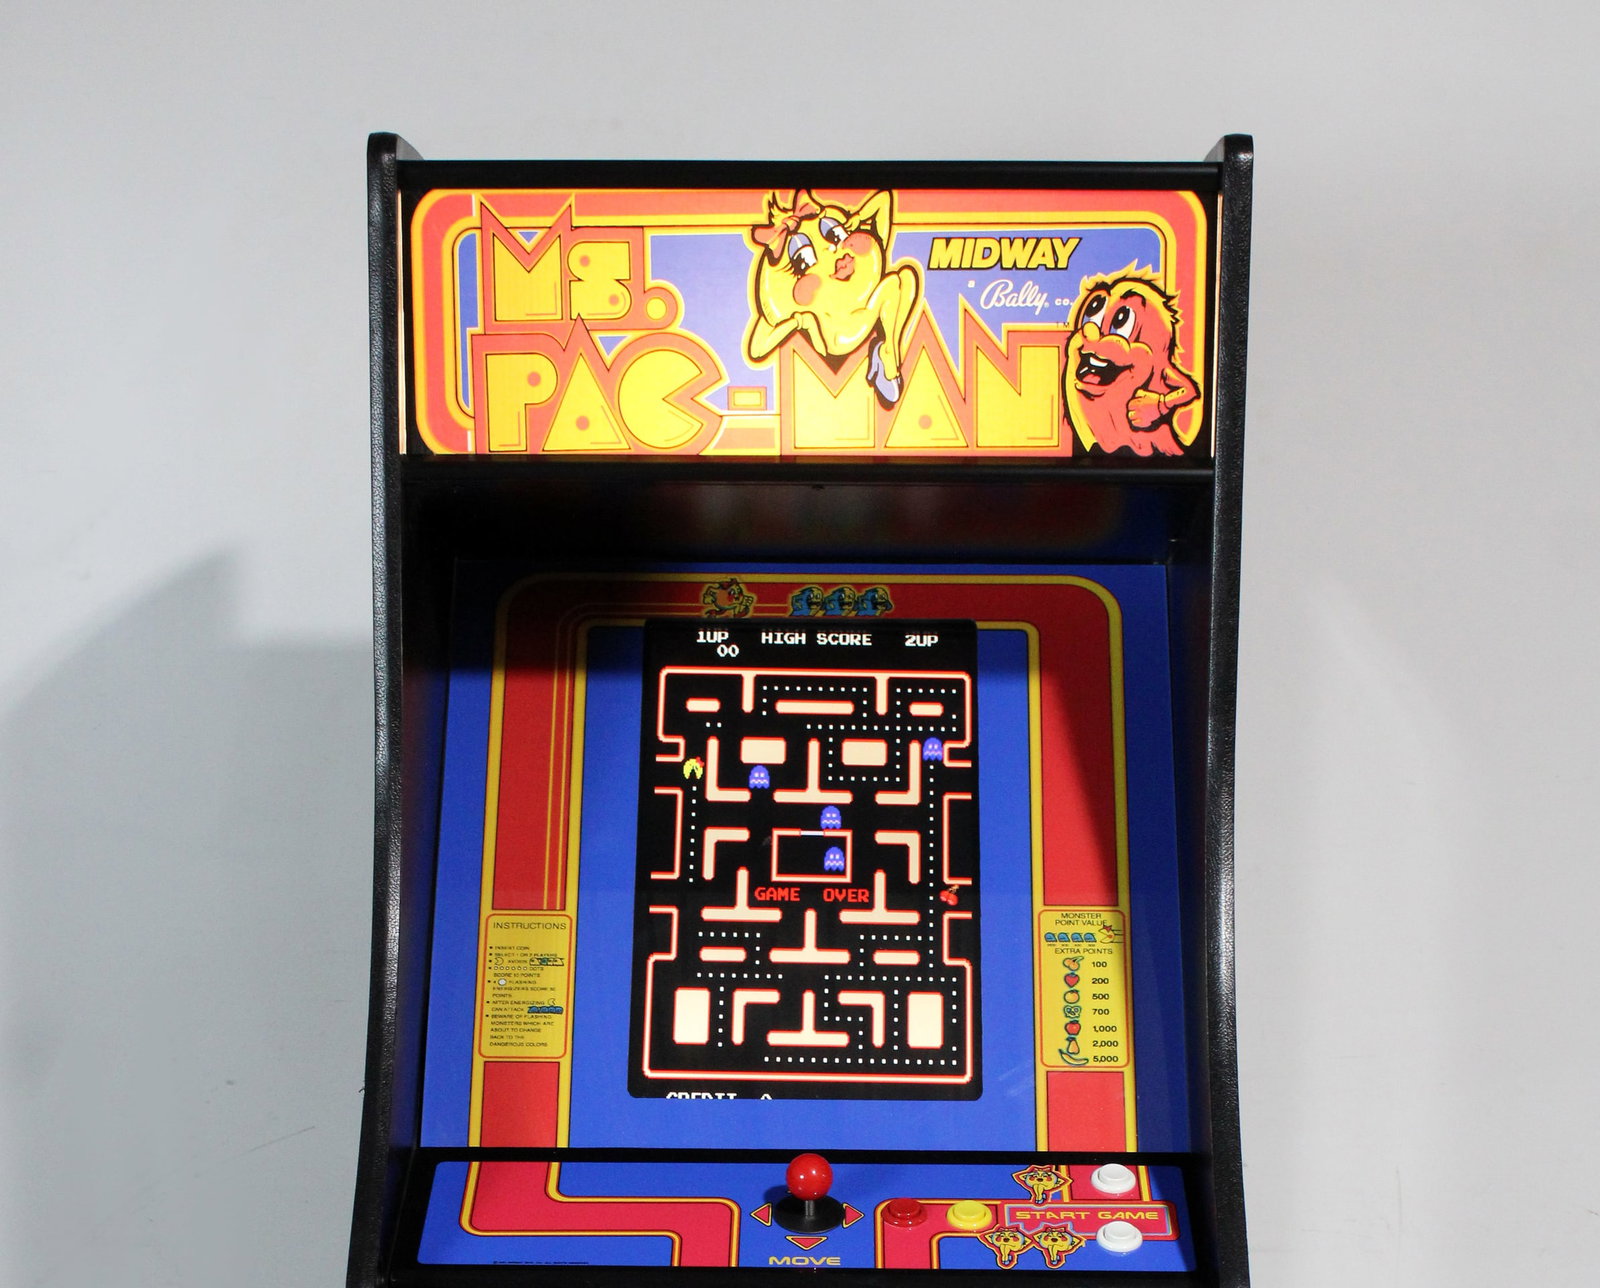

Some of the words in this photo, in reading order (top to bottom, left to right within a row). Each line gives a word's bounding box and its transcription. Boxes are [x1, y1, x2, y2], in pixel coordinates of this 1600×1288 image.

[927, 237, 1083, 270] MIDWAY
[476, 318, 1068, 454] PAC-MAN
[696, 631, 729, 643] 1UP
[761, 632, 806, 645] HIGH
[816, 633, 872, 646] SCORE
[904, 634, 939, 647] 2UP
[717, 645, 740, 658] 00
[754, 887, 800, 901] GAME
[823, 888, 869, 902] OVER
[493, 922, 567, 930] INSTRUCTIONS
[1093, 1025, 1117, 1033] 1,000
[1092, 1040, 1119, 1048] 2,000
[1016, 1211, 1091, 1220] START
[1098, 1211, 1159, 1220] GAME
[768, 1256, 841, 1266] MOVE
